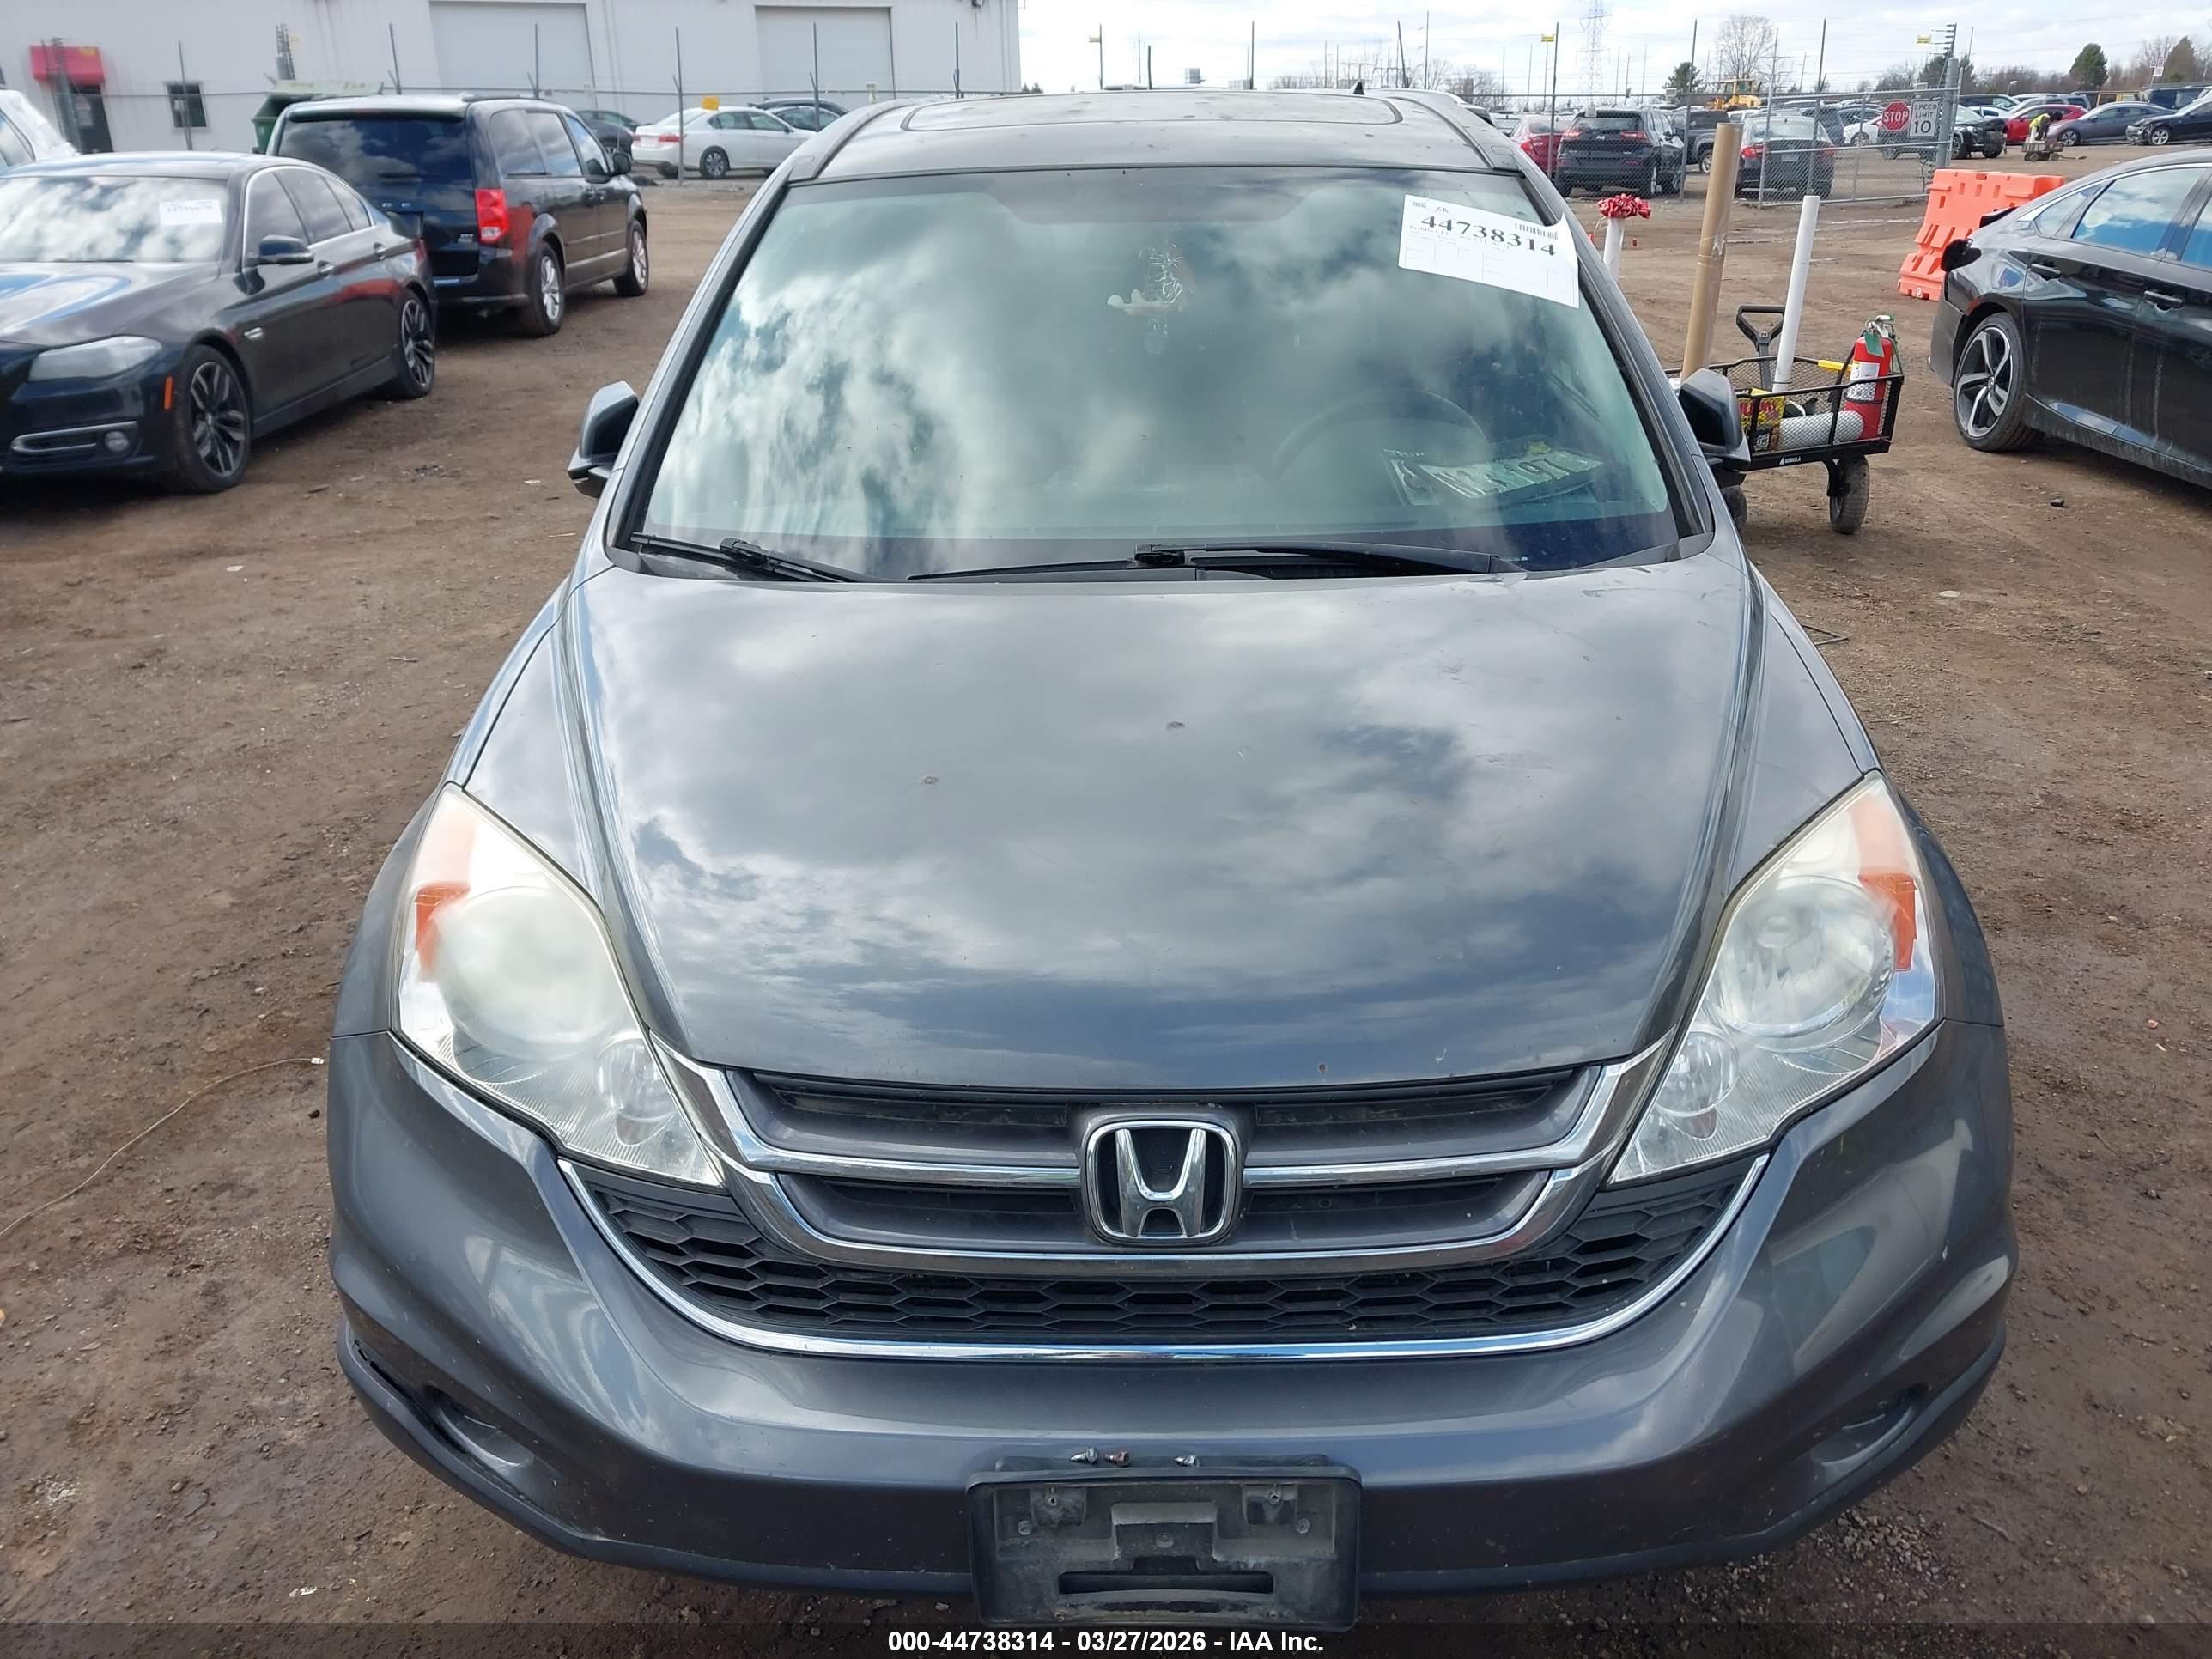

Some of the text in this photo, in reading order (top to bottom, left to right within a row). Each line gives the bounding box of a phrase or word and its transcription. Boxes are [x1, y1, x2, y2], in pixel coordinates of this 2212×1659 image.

[1883, 111, 1909, 123] STOP
[1914, 120, 1931, 133] 10
[1421, 216, 1556, 256] 44738314
